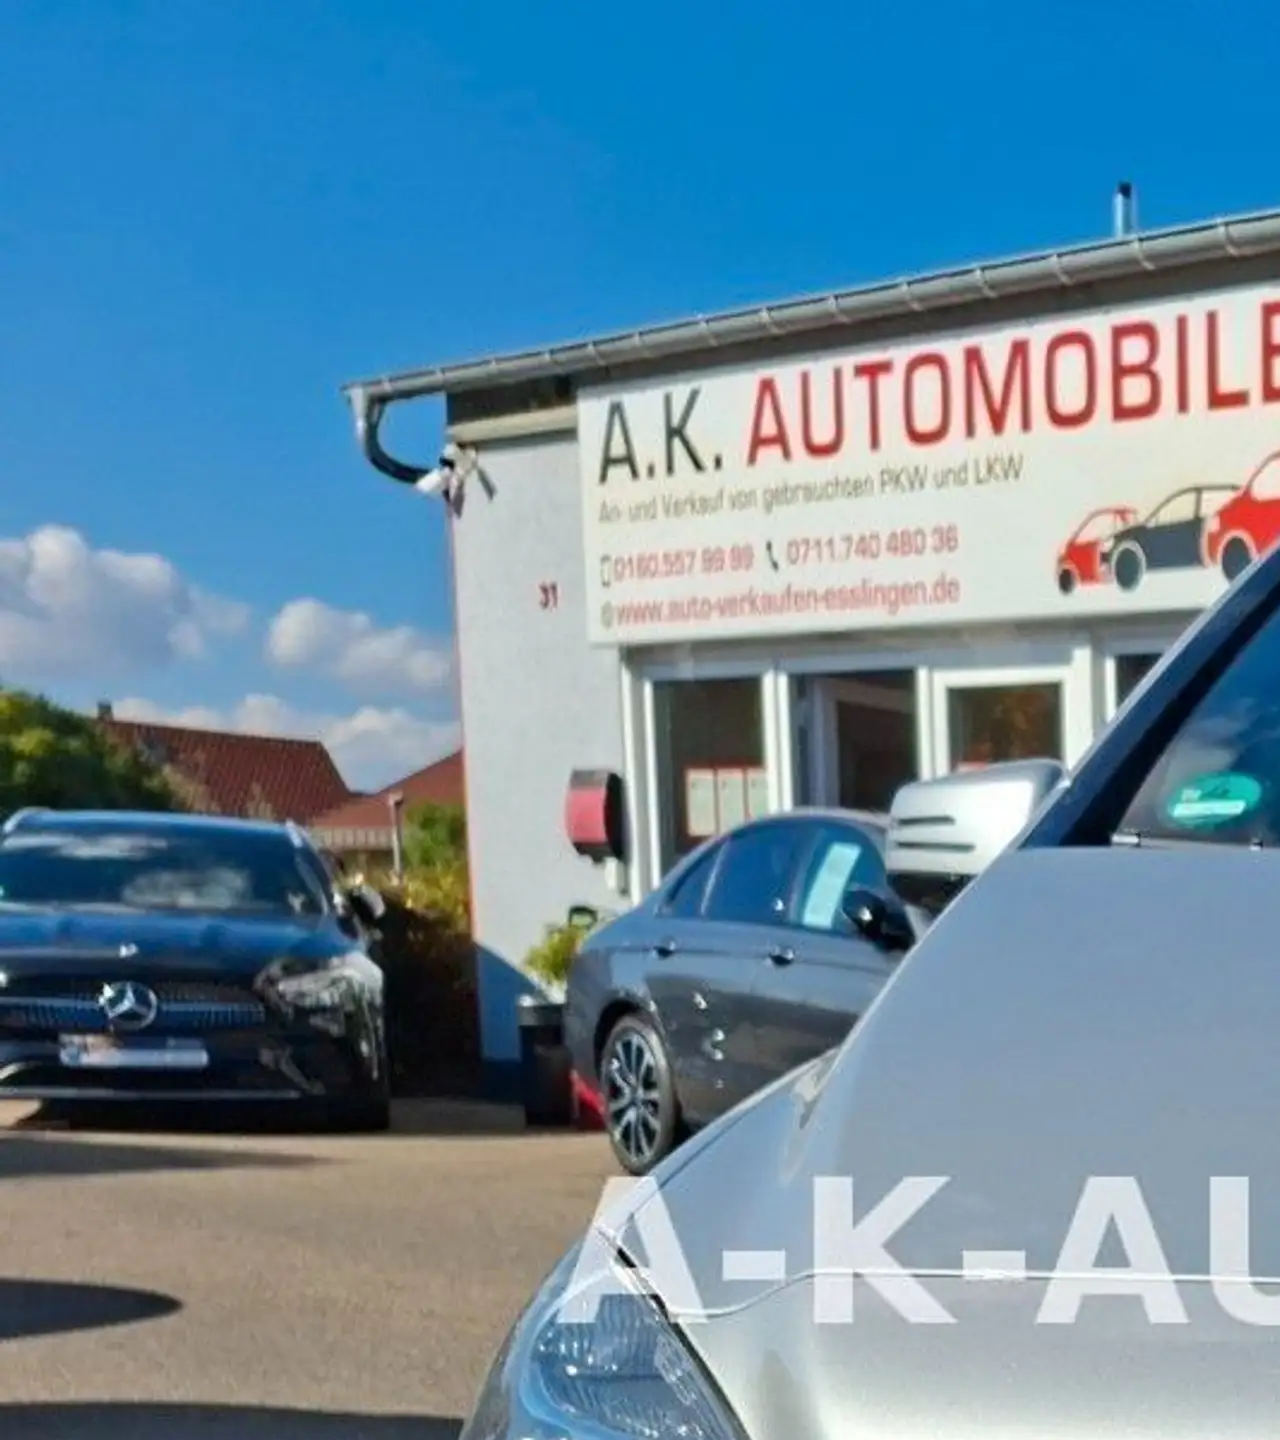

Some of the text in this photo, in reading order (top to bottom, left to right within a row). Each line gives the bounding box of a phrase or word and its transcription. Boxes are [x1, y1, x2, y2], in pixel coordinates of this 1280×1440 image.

[599, 388, 723, 484] A.K.
[662, 488, 724, 518] Verkauf
[763, 474, 874, 513] gebrauchten
[880, 464, 927, 493] PKW
[933, 462, 967, 488] und
[974, 454, 1024, 485] LKW
[786, 530, 881, 565] 0711.740
[617, 572, 961, 624] www.auto-verkaufen-esslingen.de
